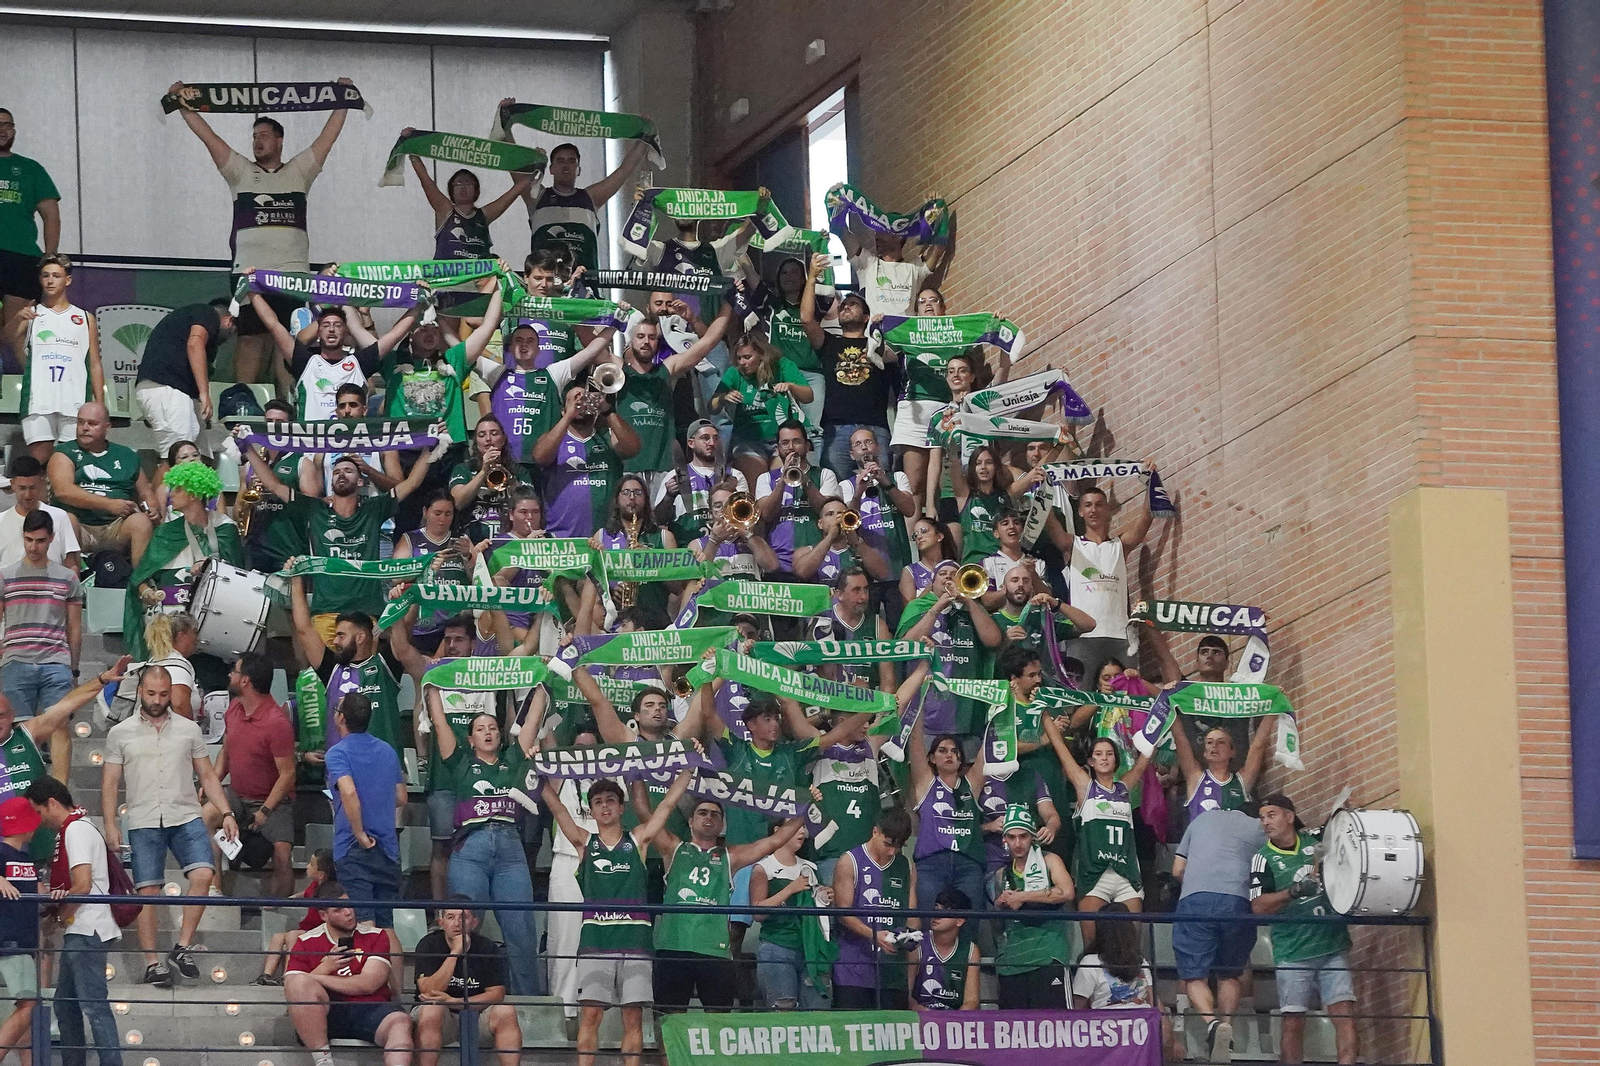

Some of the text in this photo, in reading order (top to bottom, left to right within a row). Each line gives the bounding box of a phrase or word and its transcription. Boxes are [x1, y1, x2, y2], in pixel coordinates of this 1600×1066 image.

[209, 86, 336, 105] UNICAJA
[553, 110, 601, 125] UNICAJA
[541, 120, 612, 137] BALONCESTO
[442, 135, 491, 153] UNICAJA
[430, 144, 500, 167] BALONCESTO
[676, 191, 726, 202] UNICAJA
[666, 202, 737, 215] BALONCESTO
[358, 264, 422, 280] UNICAJA
[265, 274, 317, 293] UNICAJA
[319, 280, 402, 300] BALONCESTO
[598, 270, 710, 291] UNICAJA BALONCESTO
[917, 318, 954, 331] UNICAJA
[55, 338, 79, 346] Unicaja
[910, 330, 963, 343] BALONCESTO
[49, 366, 65, 382] 17
[321, 399, 336, 407] mál
[523, 392, 546, 400] Unicaja
[1002, 390, 1040, 407] Unicaja
[266, 421, 414, 448] UNICAJA
[513, 418, 533, 435] 55
[585, 462, 608, 470] Unicaja
[521, 542, 576, 555] UNICAJA
[379, 560, 423, 572] Unicaja
[510, 553, 588, 567] BALONCESTO
[739, 582, 792, 598] UNICAJA
[727, 594, 803, 613] BALONCESTO
[631, 632, 681, 647] UNICAJA
[622, 645, 692, 661] BALONCESTO
[468, 658, 521, 672] UNICAJA
[737, 655, 803, 688] UNICAJA
[455, 670, 533, 686] BALONCESTO
[780, 684, 830, 703] COPA DEL REY 2023
[1204, 686, 1260, 700] UNICAJA
[465, 702, 485, 710] Unicaj
[1194, 698, 1272, 714] BALONCESTO
[452, 715, 472, 725] mál
[535, 741, 688, 775] UNICAJA
[493, 786, 511, 794] Unic
[846, 799, 861, 818] 4
[1106, 825, 1123, 845] 11
[13, 866, 36, 877] PARIS
[689, 867, 710, 886] 43
[687, 1018, 1148, 1056] EL CARPENA, TEMPLO DEL BALONCESTO
